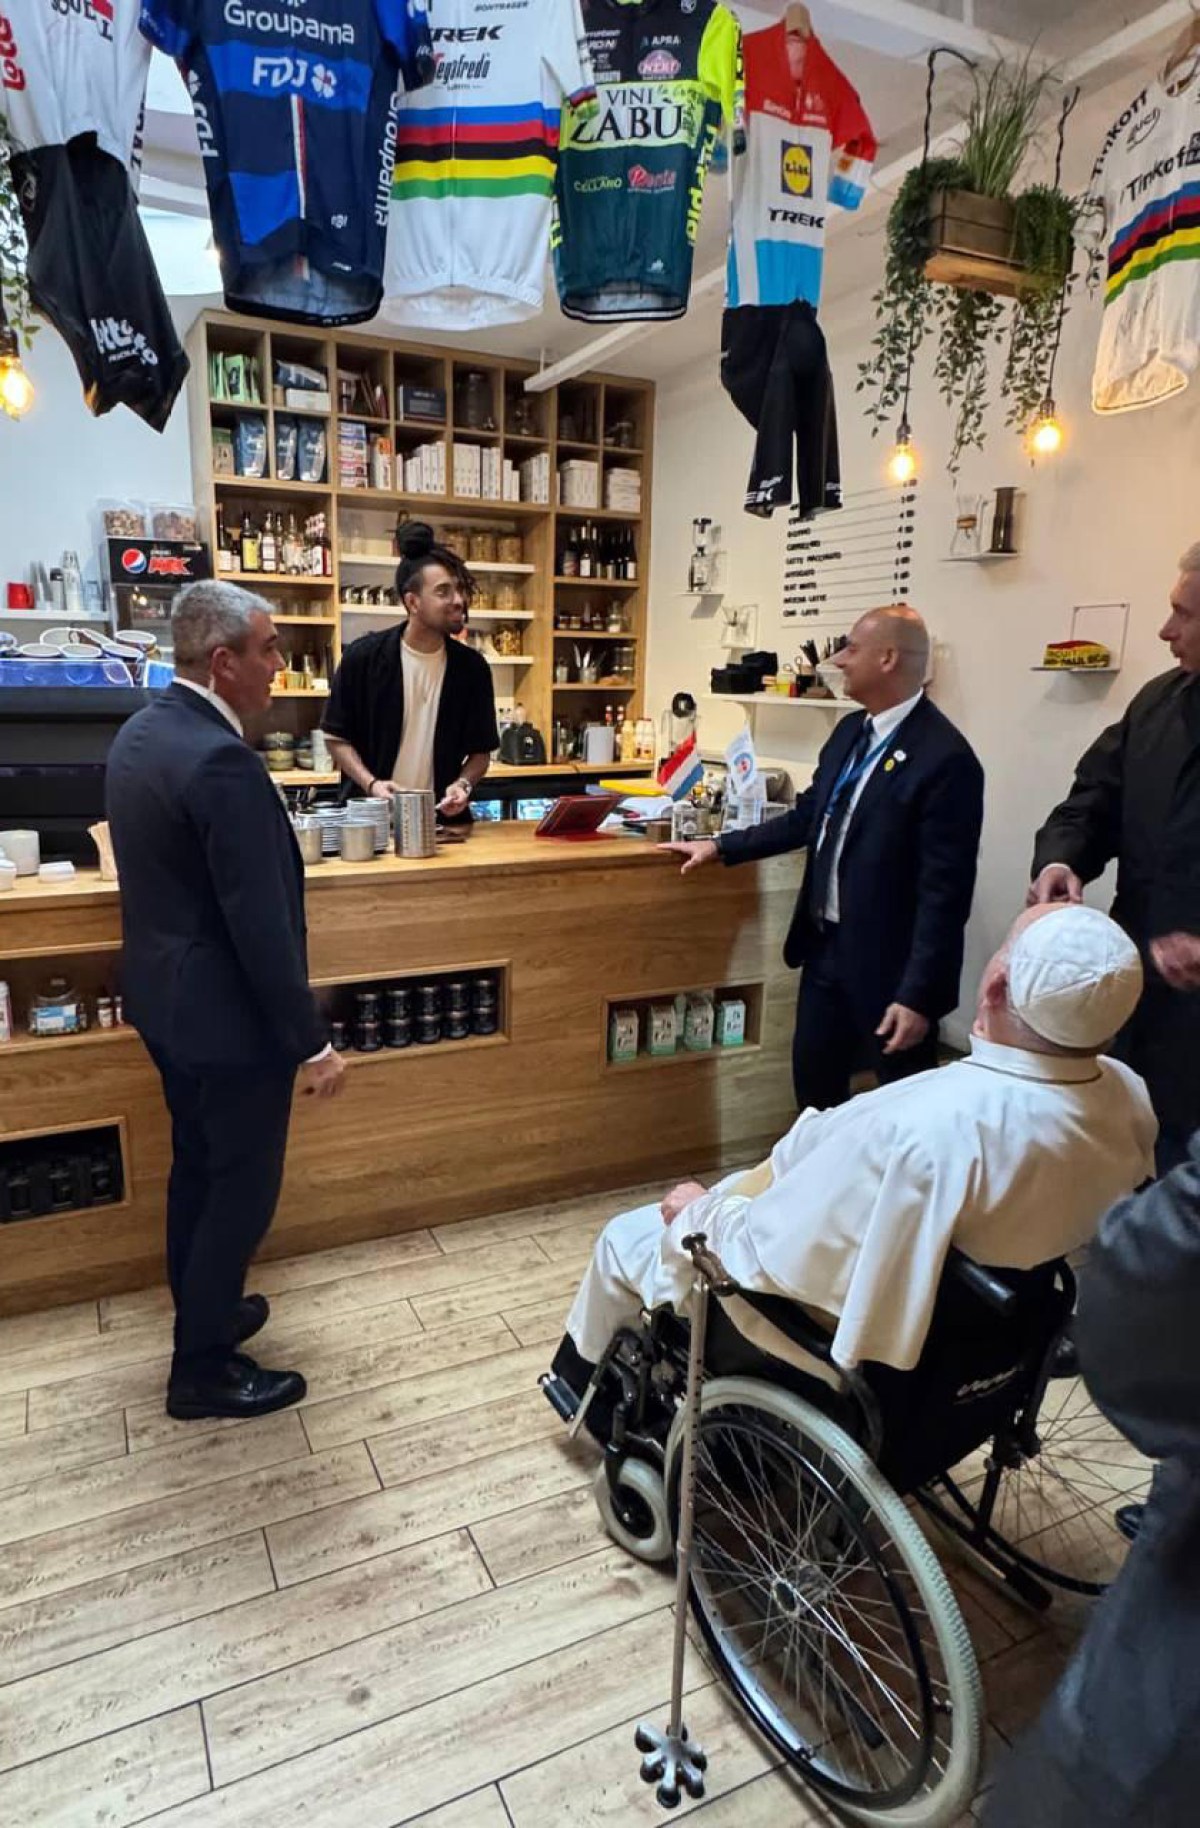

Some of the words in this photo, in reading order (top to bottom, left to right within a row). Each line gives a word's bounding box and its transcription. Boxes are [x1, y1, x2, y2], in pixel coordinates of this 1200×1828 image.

[223, 1, 355, 46] Groupama
[431, 24, 504, 42] REK
[252, 56, 308, 88] FDJ
[605, 88, 652, 106] VINI
[373, 91, 400, 227] Groupama
[767, 207, 825, 229] TREK
